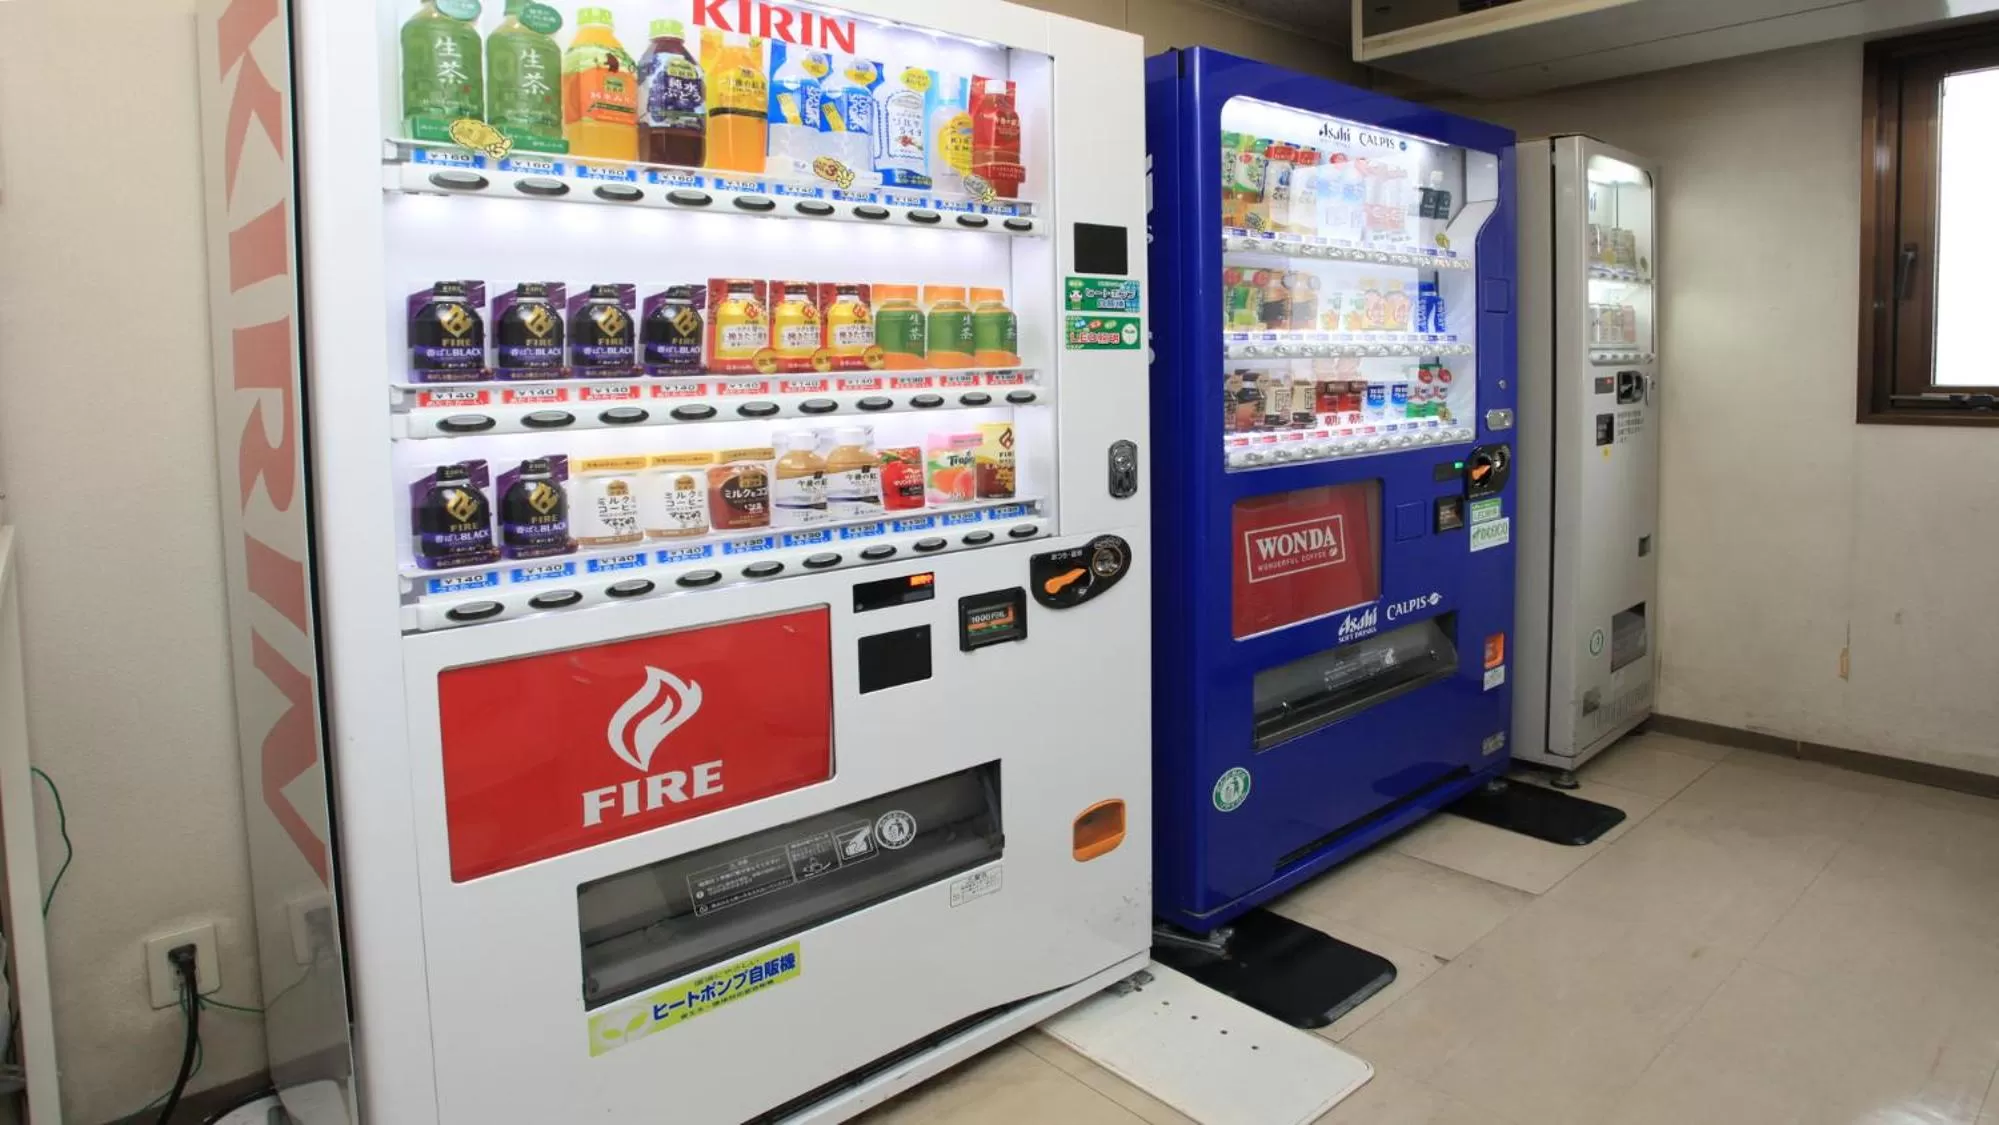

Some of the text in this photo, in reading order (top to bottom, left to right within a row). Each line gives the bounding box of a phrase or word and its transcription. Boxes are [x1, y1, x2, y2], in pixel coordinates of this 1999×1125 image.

[692, 0, 856, 54] KIRIN
[434, 36, 468, 85] 生茶
[519, 48, 550, 95] 生茶
[1319, 123, 1395, 149] Asahi CALPIS
[909, 314, 923, 341] 生茶
[960, 314, 973, 341] 生茶
[436, 391, 475, 400] ¥140
[518, 389, 554, 397] ¥140
[217, 0, 332, 890] KIRIN
[450, 524, 478, 532] FIRE
[531, 515, 559, 524] FIRE
[671, 547, 702, 556] ¥140
[1255, 525, 1338, 560] WONDA
[527, 564, 563, 574] ¥140
[602, 555, 633, 565] ¥140
[1257, 550, 1327, 572] WONDERFUL COFFEE
[445, 576, 483, 585] ¥140
[1338, 596, 1427, 636] Asahi CALPIS
[582, 760, 724, 828] FIRE
[652, 952, 796, 1021] ヒートポンプ自販機
